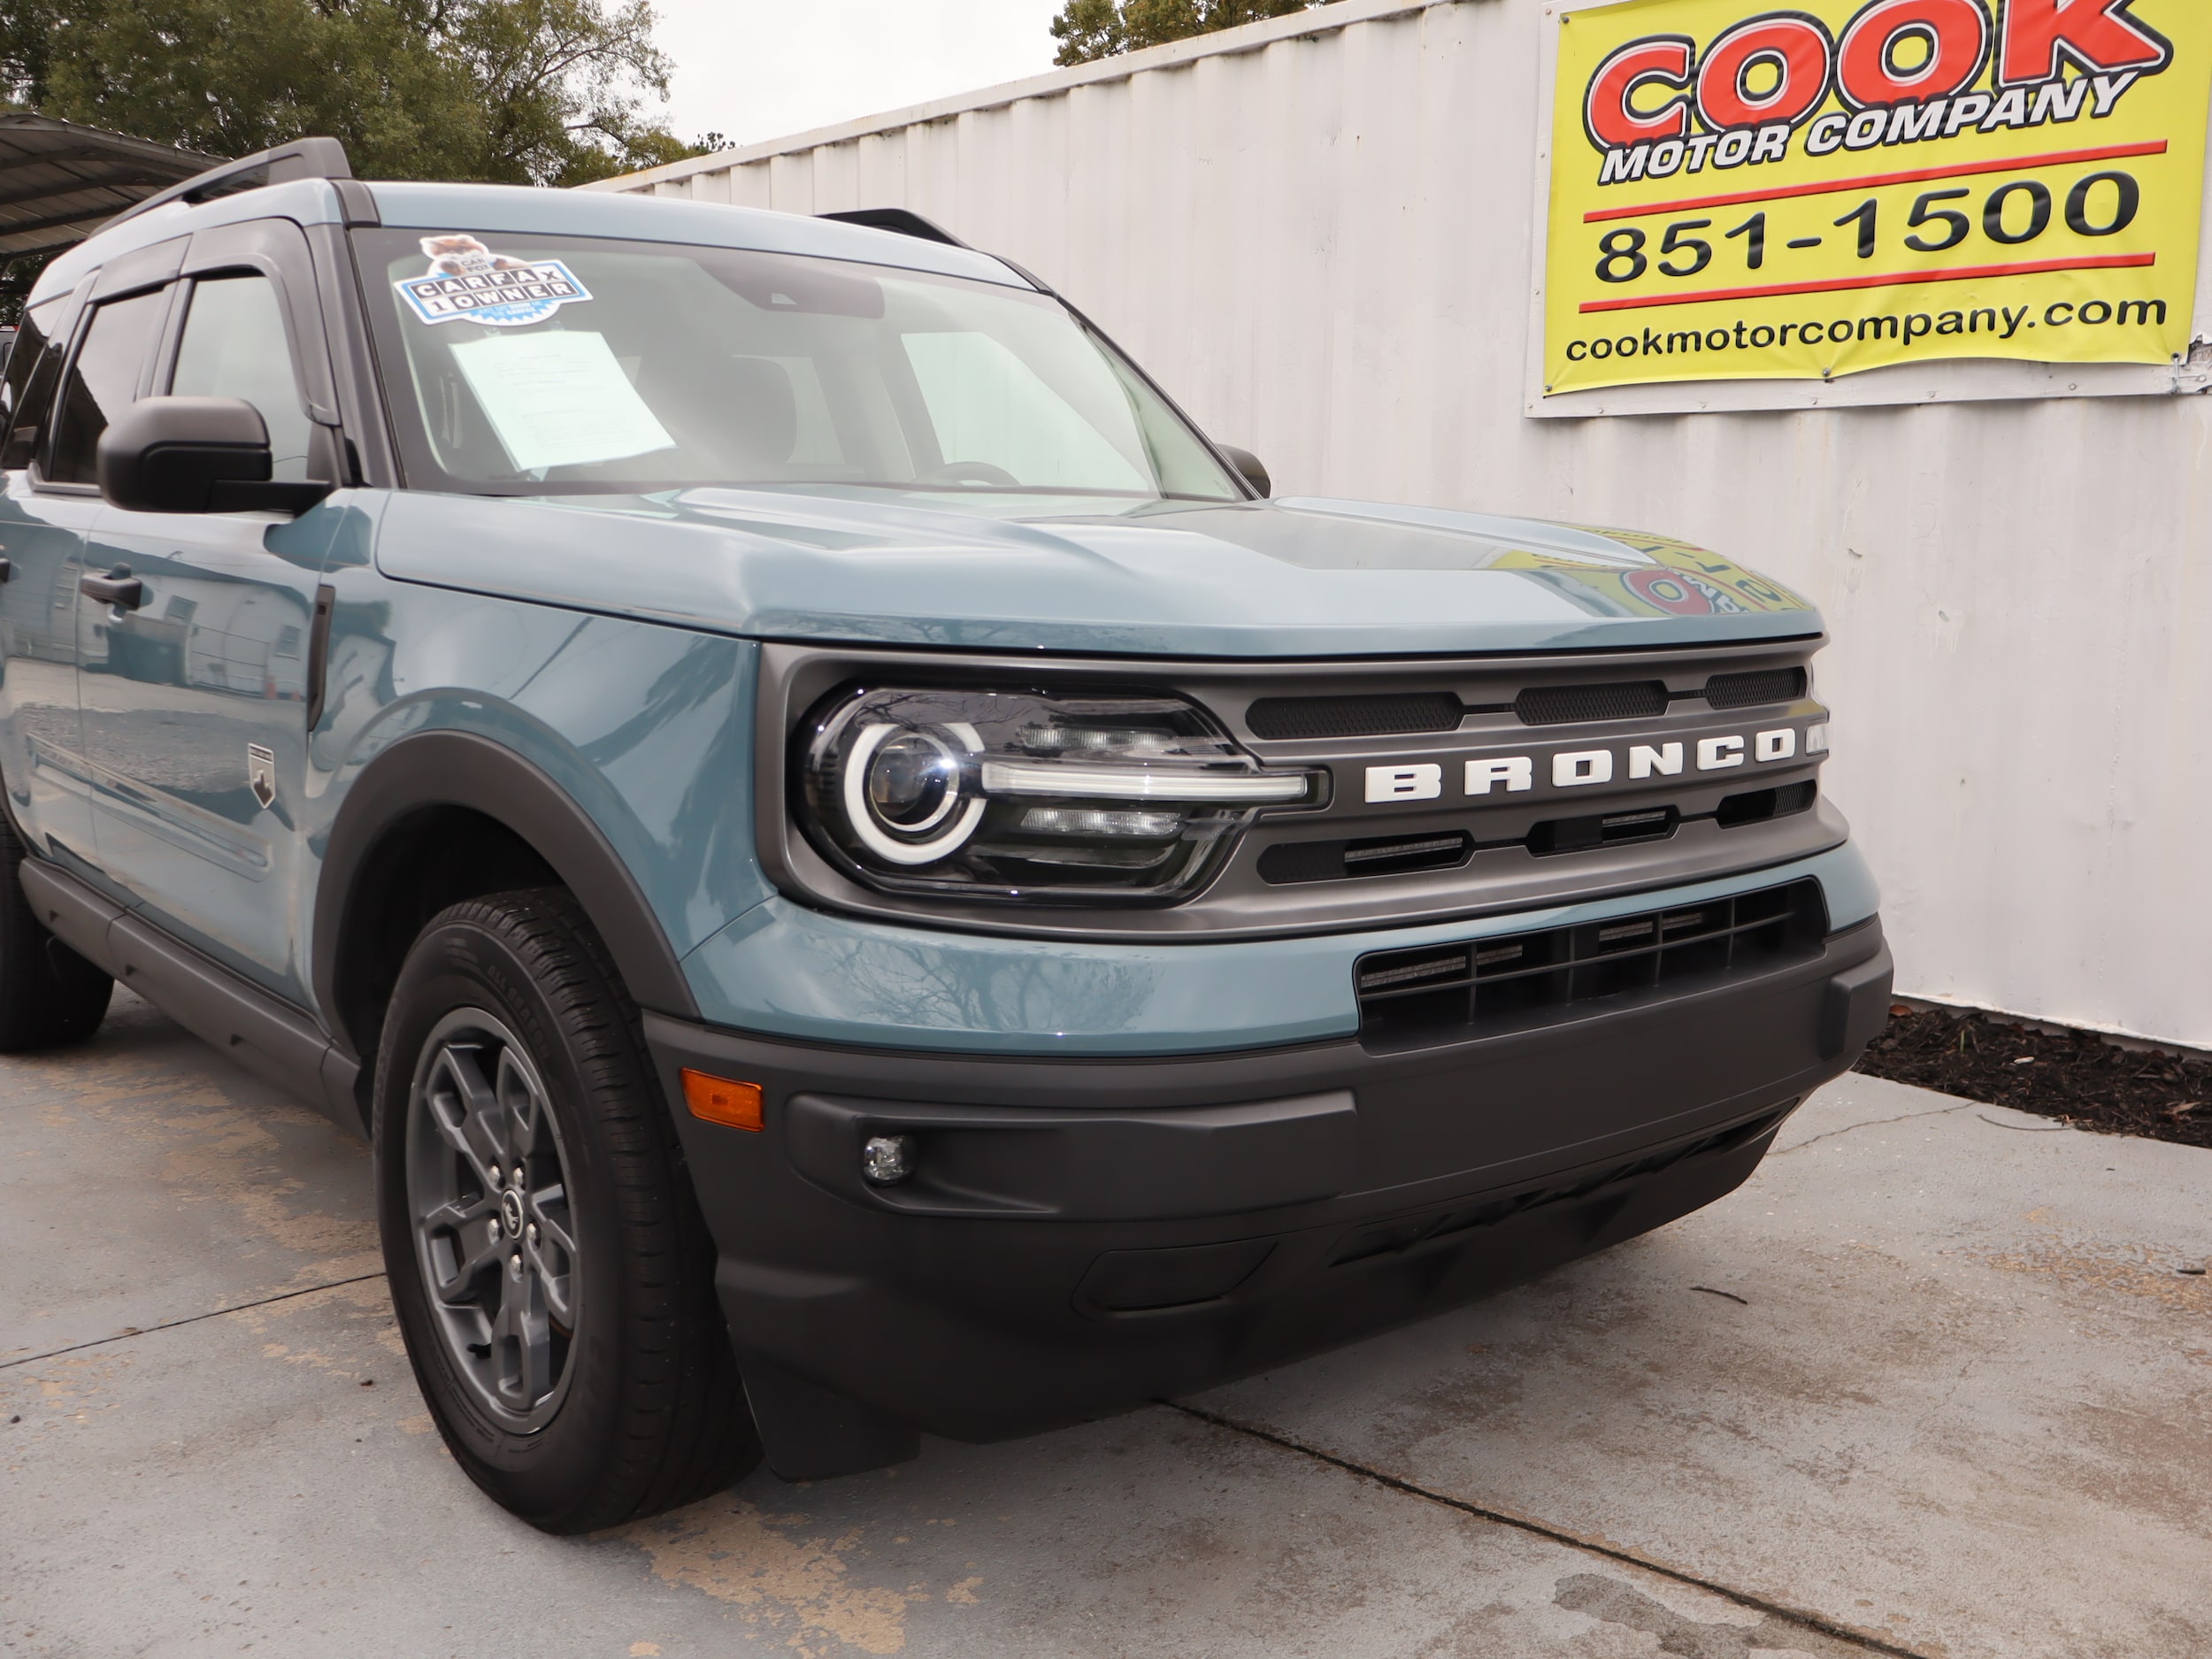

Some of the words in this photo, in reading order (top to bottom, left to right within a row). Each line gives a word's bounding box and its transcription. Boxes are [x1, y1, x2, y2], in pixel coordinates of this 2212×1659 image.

[1584, 0, 2173, 149] COOK
[1599, 123, 1791, 183] MOTOR
[1807, 71, 2139, 155] COMPANY
[461, 257, 486, 266] CAR
[1594, 171, 2139, 283] 851-1500
[417, 270, 558, 297] CARFAX
[430, 301, 449, 311] 1
[452, 282, 572, 309] OWNER
[1566, 298, 2166, 362] cookmotorcompany.com
[1364, 728, 1795, 803] BRONCO
